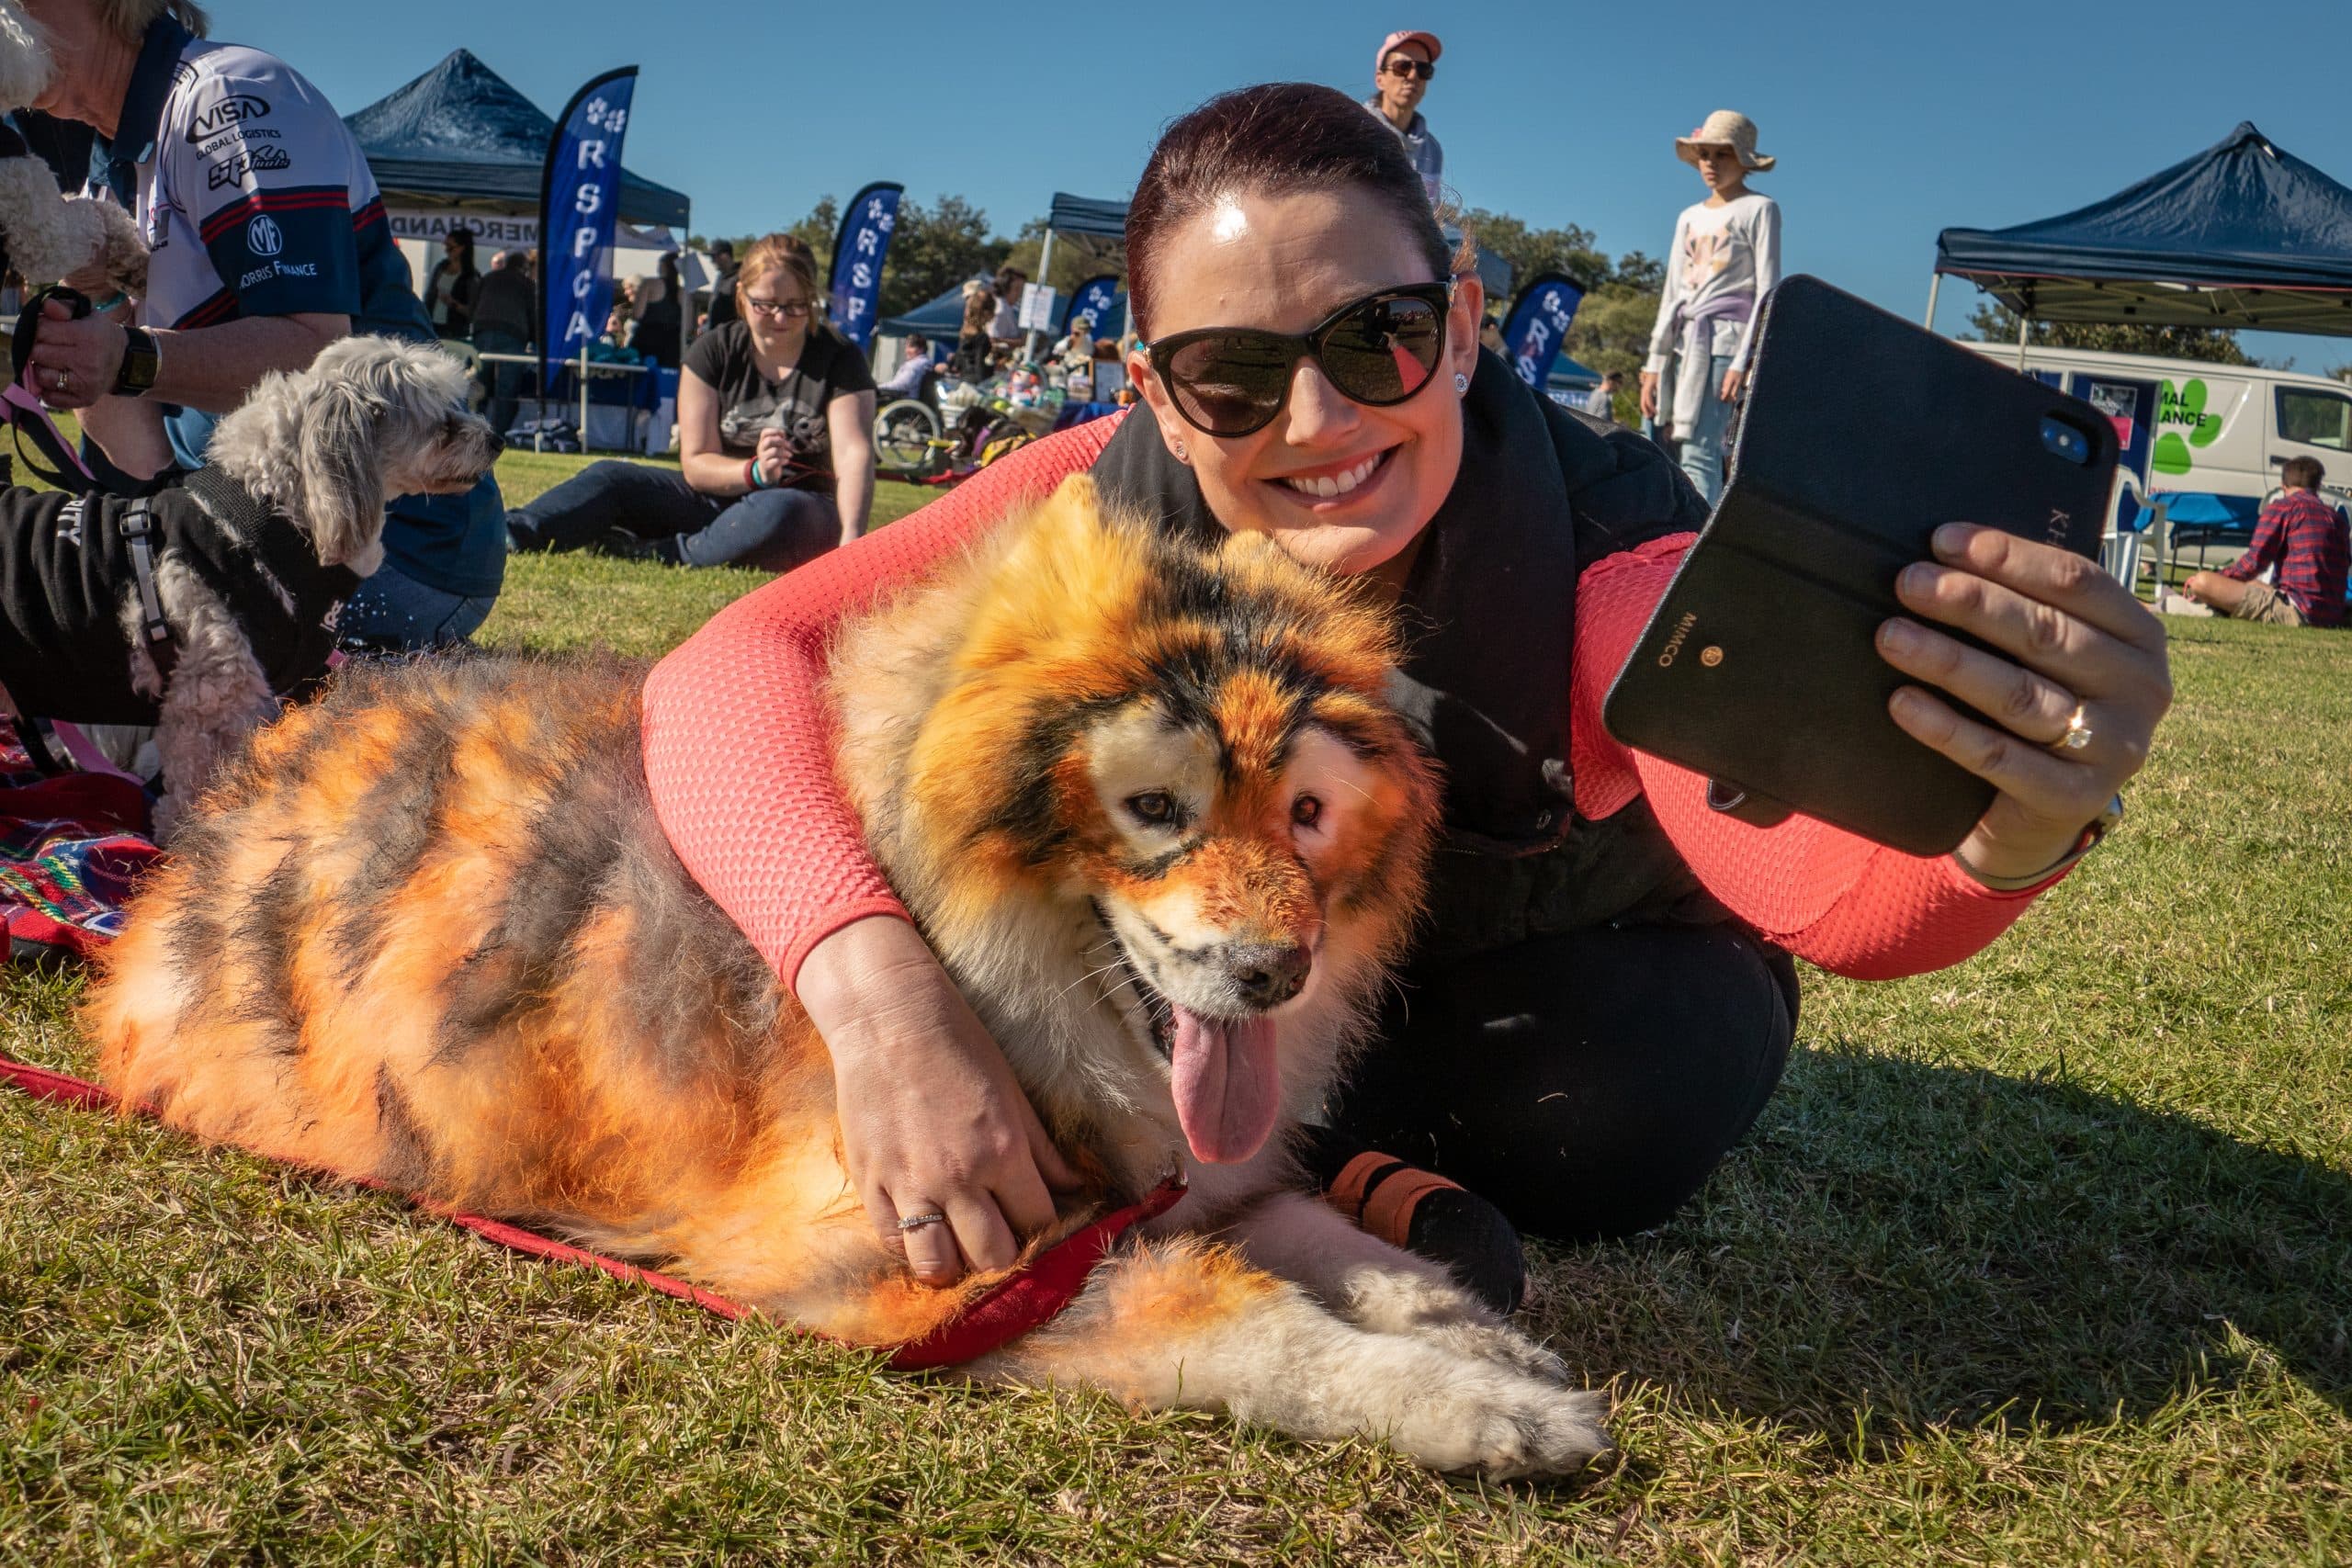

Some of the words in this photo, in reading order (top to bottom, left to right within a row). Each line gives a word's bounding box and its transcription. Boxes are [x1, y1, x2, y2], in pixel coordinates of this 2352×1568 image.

[195, 98, 267, 131] VISA
[196, 137, 232, 161] GLOBAL
[232, 129, 281, 143] LOGISTICS
[564, 139, 605, 342] RSPCA
[238, 265, 273, 290] ORRIS
[847, 227, 879, 342] RSP
[1659, 611, 1697, 667] MIMCO
